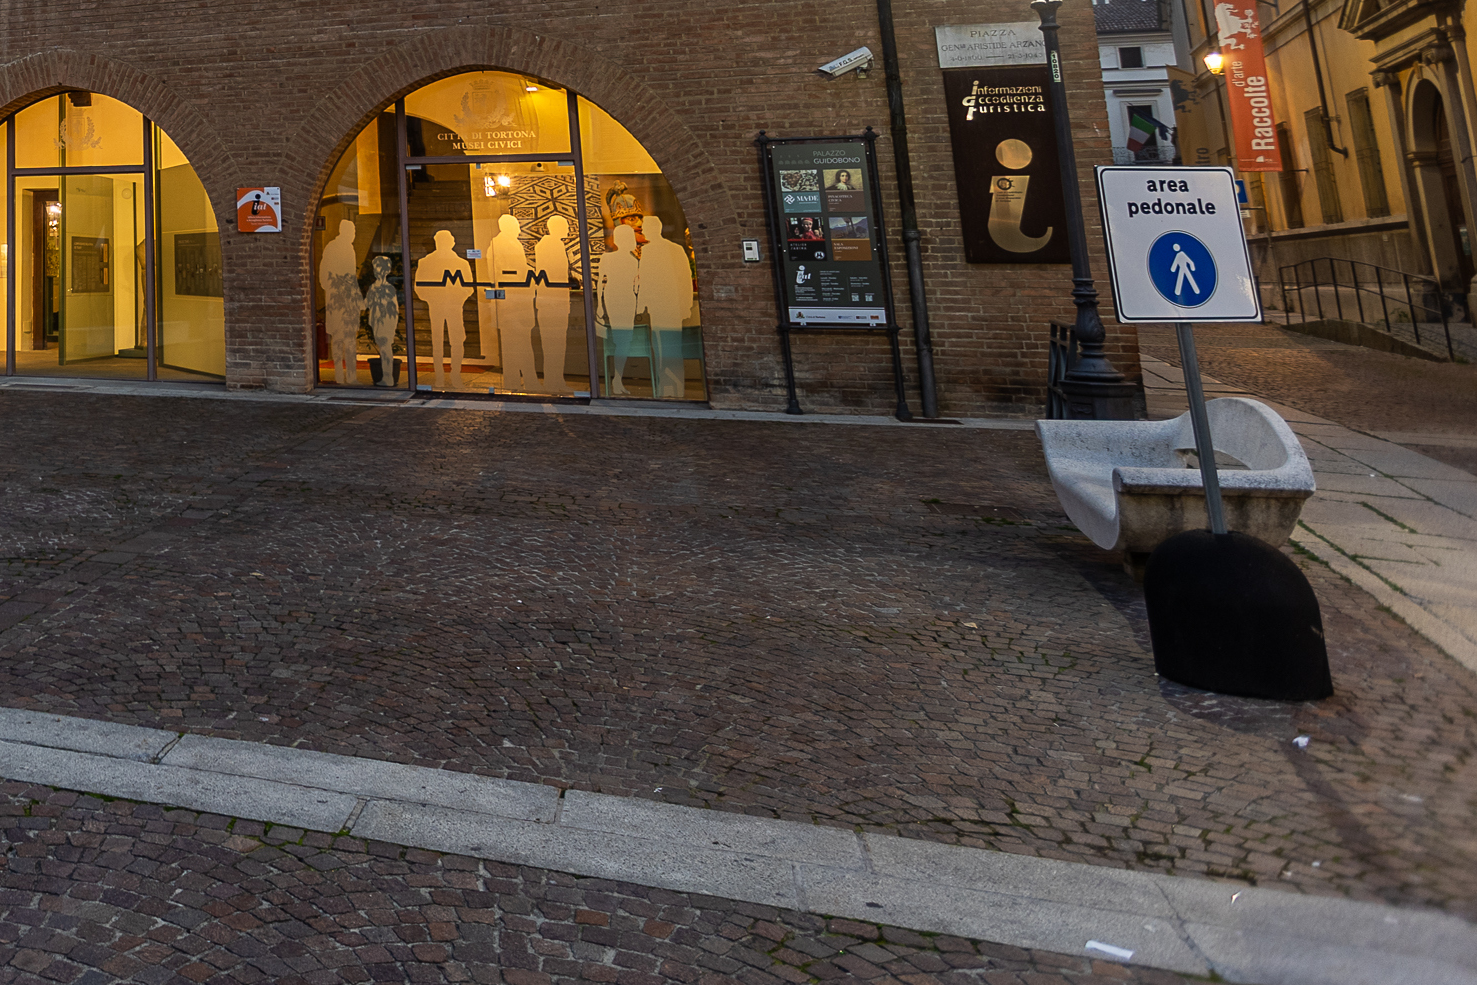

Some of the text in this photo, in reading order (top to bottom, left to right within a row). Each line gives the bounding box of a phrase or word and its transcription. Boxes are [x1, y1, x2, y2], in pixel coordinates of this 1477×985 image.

[970, 29, 1017, 38] PIAZZA
[967, 41, 1007, 51] ARISTIDE
[1231, 61, 1245, 87] d'arte
[1244, 76, 1275, 150] Raccolte
[472, 132, 482, 140] DI
[485, 130, 537, 139] TORTONA
[452, 140, 522, 150] MUSEI CIVICI
[812, 149, 846, 157] PALAZZO
[813, 157, 861, 165] GUIDOBONO
[1146, 179, 1189, 192] area
[1127, 198, 1216, 218] pedonale
